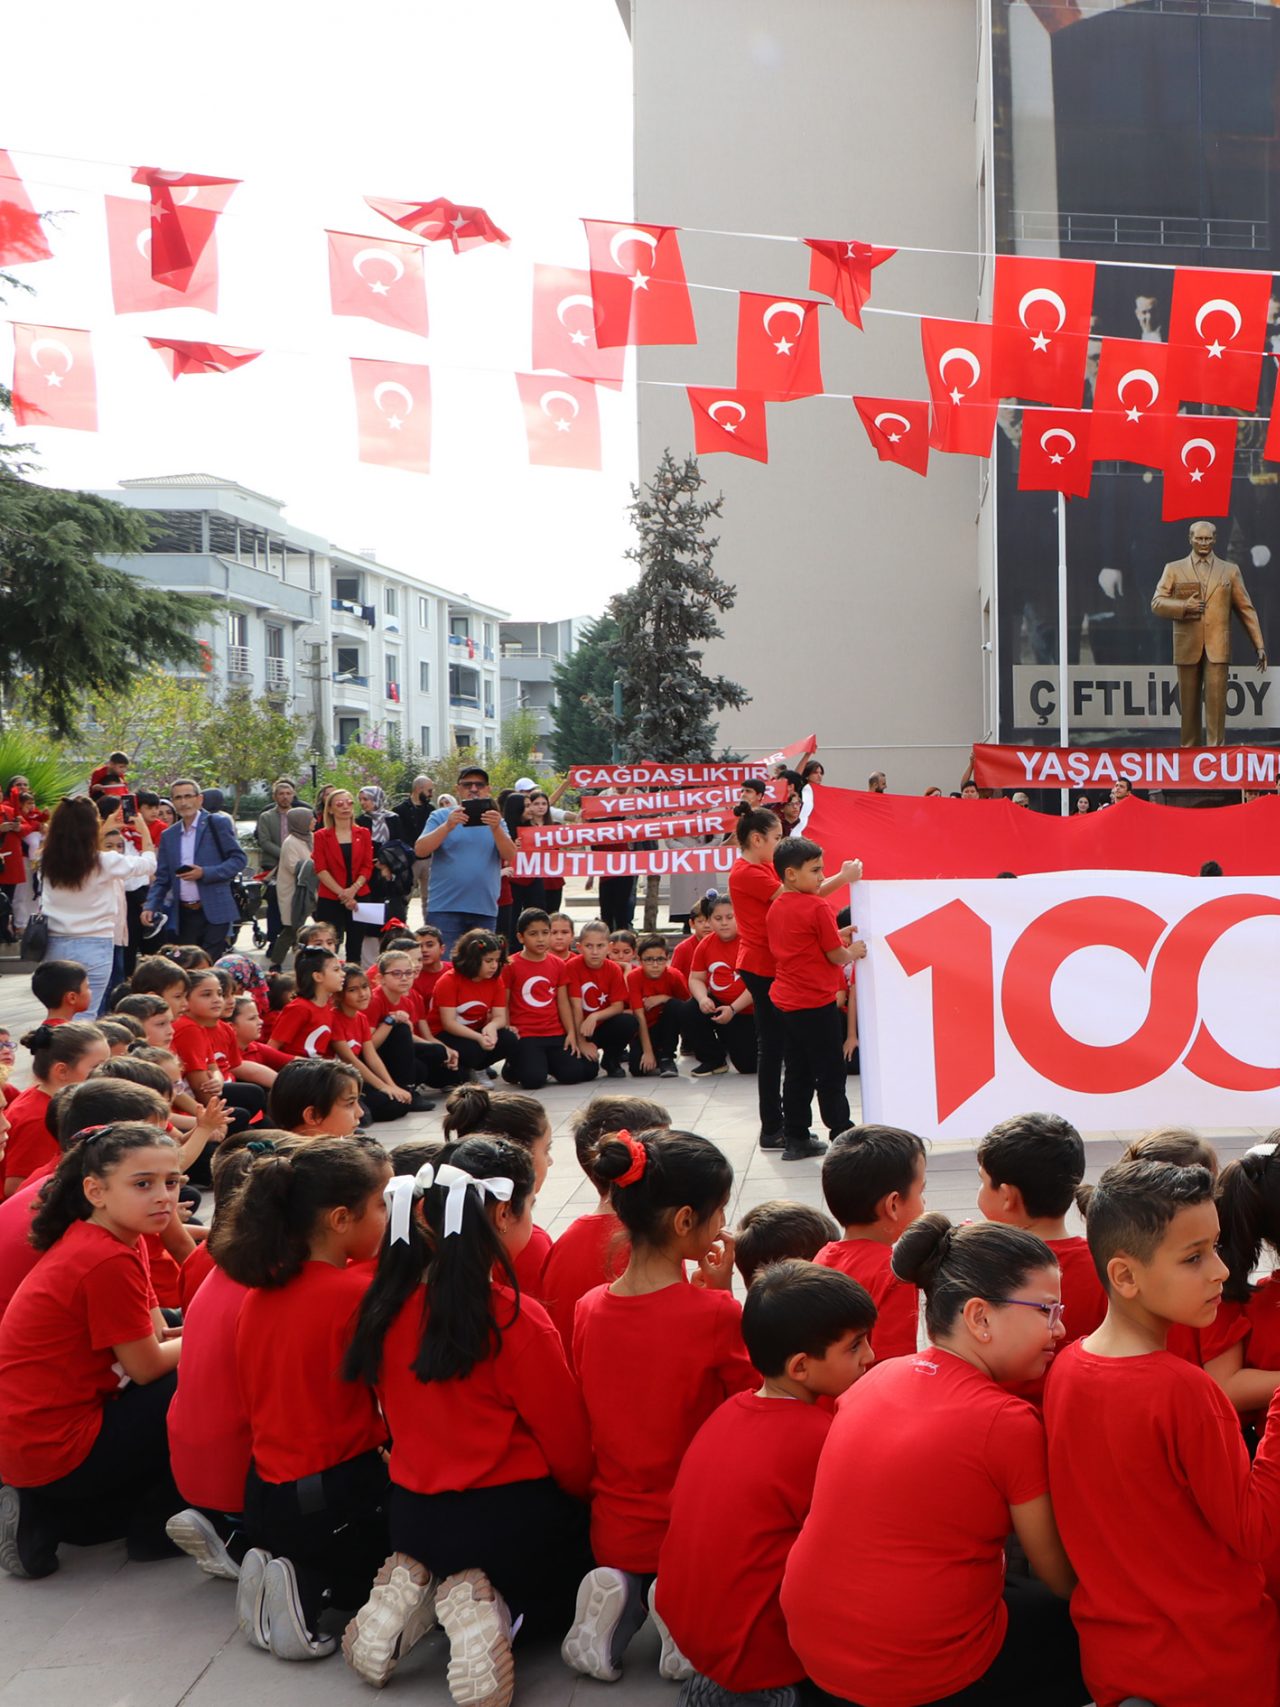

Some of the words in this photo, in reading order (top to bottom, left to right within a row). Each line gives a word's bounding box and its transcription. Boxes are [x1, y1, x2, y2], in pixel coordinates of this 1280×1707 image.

[1029, 672, 1271, 725] ÇFTLİKÖY
[574, 765, 769, 787] ÇAĞDAŞLIKTIR
[1016, 751, 1180, 788] YAŞASIN
[534, 814, 724, 848] HÜRRİYETTİR
[516, 847, 743, 875] MUTLULUKTU
